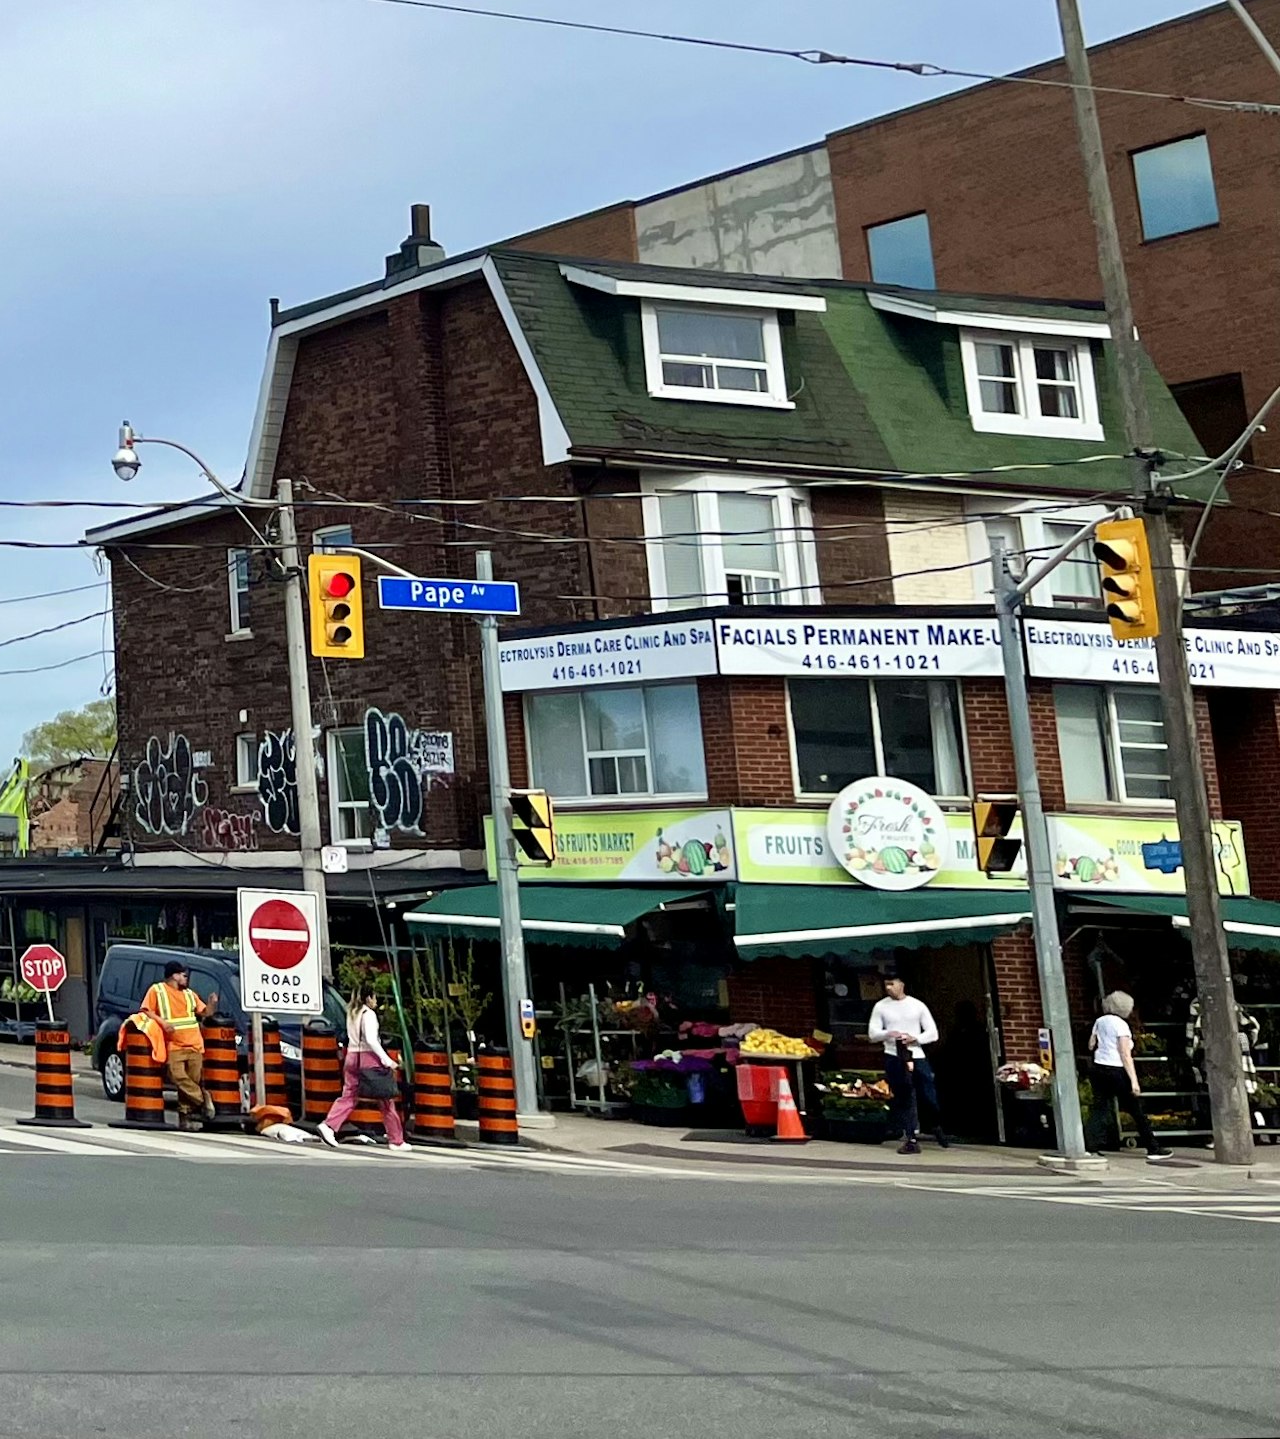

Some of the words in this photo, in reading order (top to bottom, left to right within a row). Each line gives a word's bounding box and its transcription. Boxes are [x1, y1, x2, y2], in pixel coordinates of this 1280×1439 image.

[410, 581, 465, 608] Pape
[470, 584, 486, 596] Av
[500, 645, 555, 662] ECTROLYSIS
[556, 640, 592, 657] DERMA
[594, 637, 622, 653] CARE
[624, 634, 661, 651] CLINIC
[663, 630, 687, 647] AND
[689, 627, 713, 645] SPA
[719, 624, 798, 646] FACIALS
[802, 624, 920, 646] PERMANENT
[926, 624, 1002, 646] MAKE-U
[1028, 626, 1114, 648] ELECTROLYSIS
[1195, 636, 1234, 654] CLINIC
[1237, 638, 1262, 656] AND
[1264, 638, 1280, 657] SP
[552, 659, 642, 680] 416-461-1021
[801, 654, 941, 670] 416-461-1021
[858, 814, 914, 835] Fresh
[565, 833, 598, 851] FRUITS
[600, 832, 634, 852] MARKET
[765, 835, 824, 856] FRUITS
[25, 959, 62, 977] STOP
[261, 974, 301, 987] ROAD
[253, 991, 310, 1005] CLOSED
